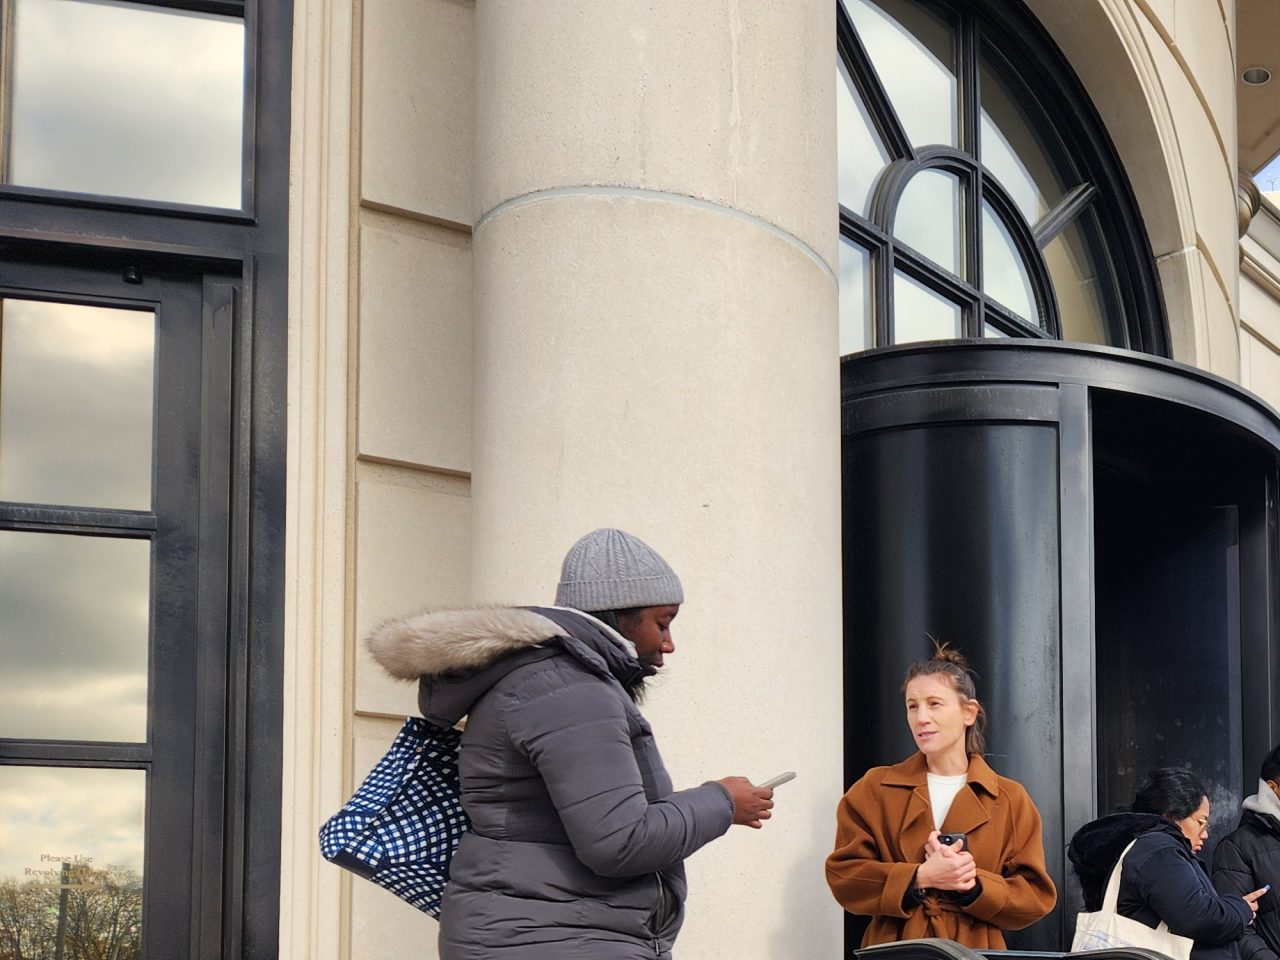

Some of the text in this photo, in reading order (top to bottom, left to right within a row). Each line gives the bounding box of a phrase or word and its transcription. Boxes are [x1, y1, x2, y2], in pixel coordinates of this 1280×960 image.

[40, 854, 93, 863] Please Use
[24, 867, 75, 878] Revolvn
